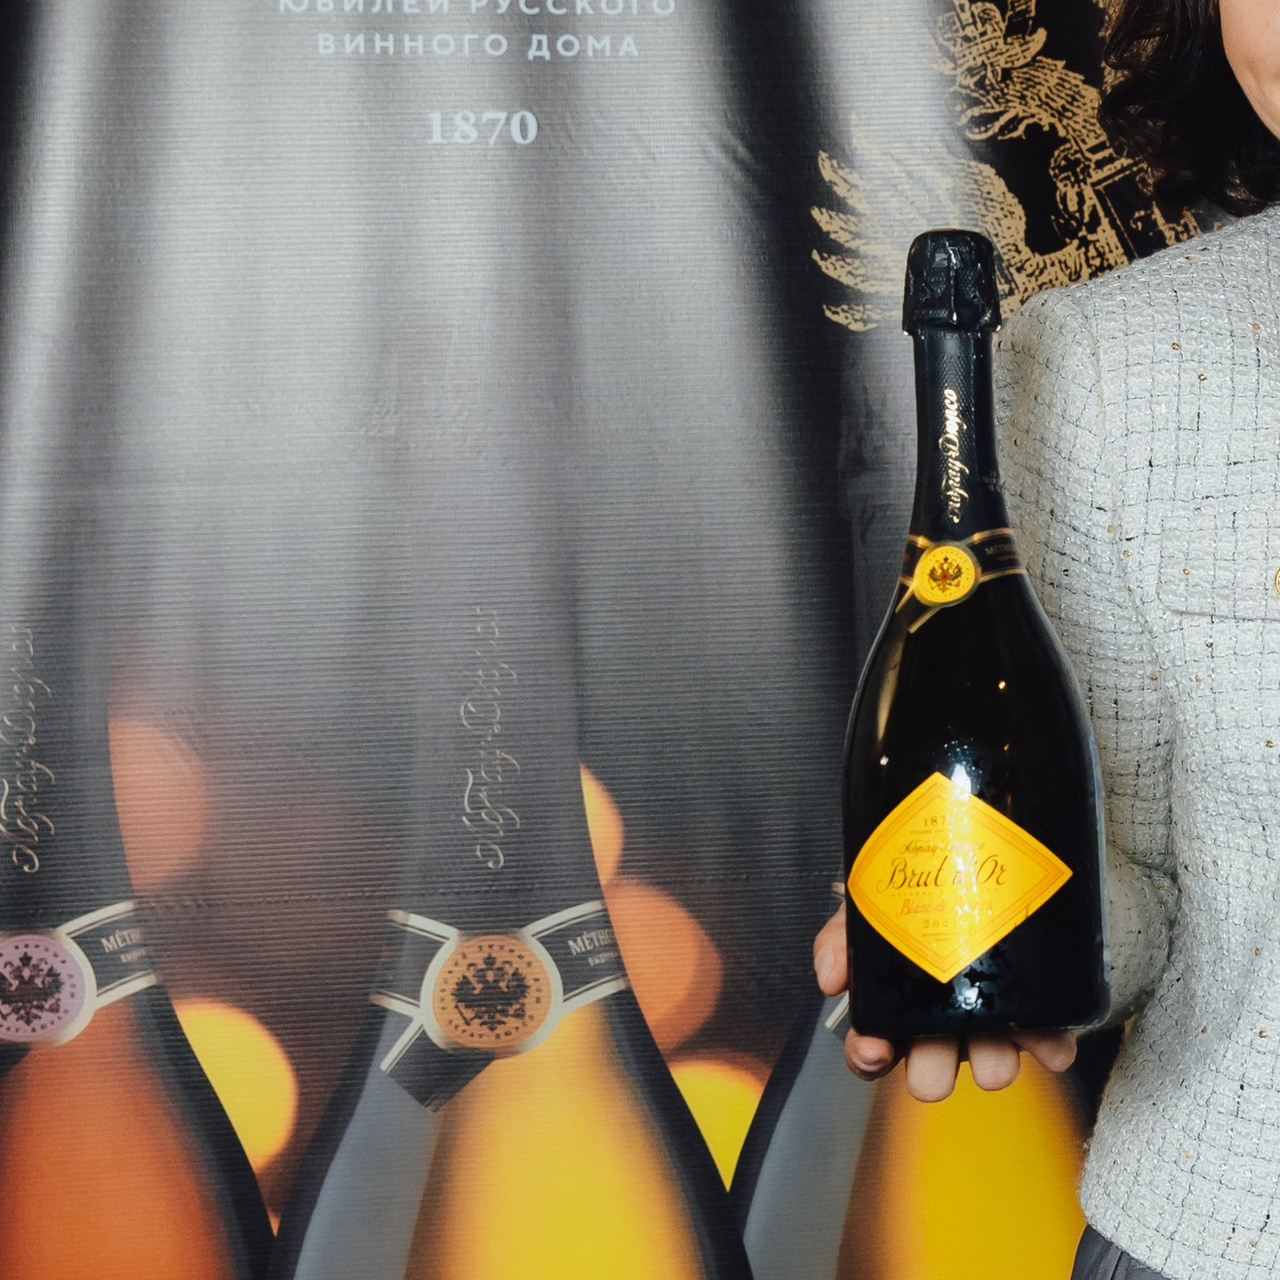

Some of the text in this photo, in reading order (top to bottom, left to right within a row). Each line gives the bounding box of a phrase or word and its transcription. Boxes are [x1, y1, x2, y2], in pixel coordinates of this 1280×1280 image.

[318, 31, 640, 62] ВИННОГО ДОМА
[427, 109, 538, 146] 1870
[876, 855, 949, 894] Brut
